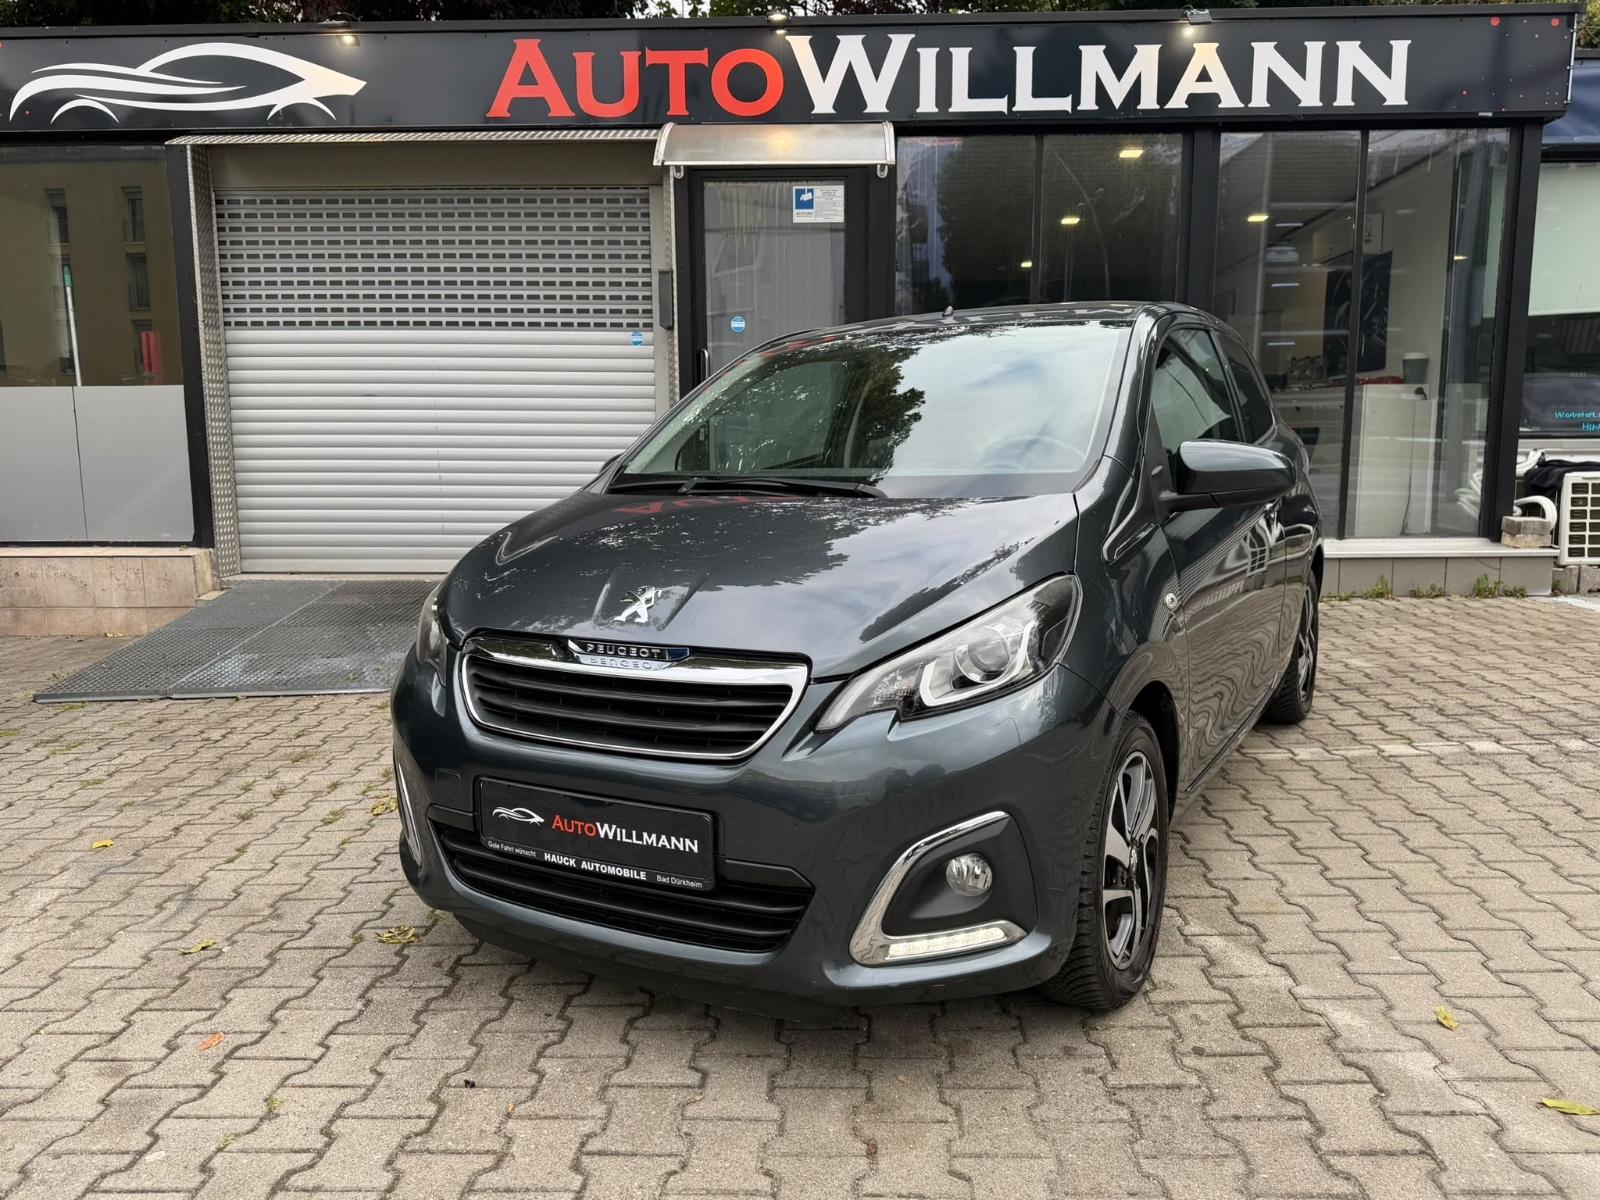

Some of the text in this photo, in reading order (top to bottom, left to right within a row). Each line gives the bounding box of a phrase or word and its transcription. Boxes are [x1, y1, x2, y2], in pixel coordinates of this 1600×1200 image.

[586, 643, 660, 659] PEUGEOT
[544, 852, 577, 867] HAUCK
[581, 860, 647, 880] AUTOMOBILE
[657, 875, 670, 884] Bad
[671, 876, 702, 889] Dürkheim
